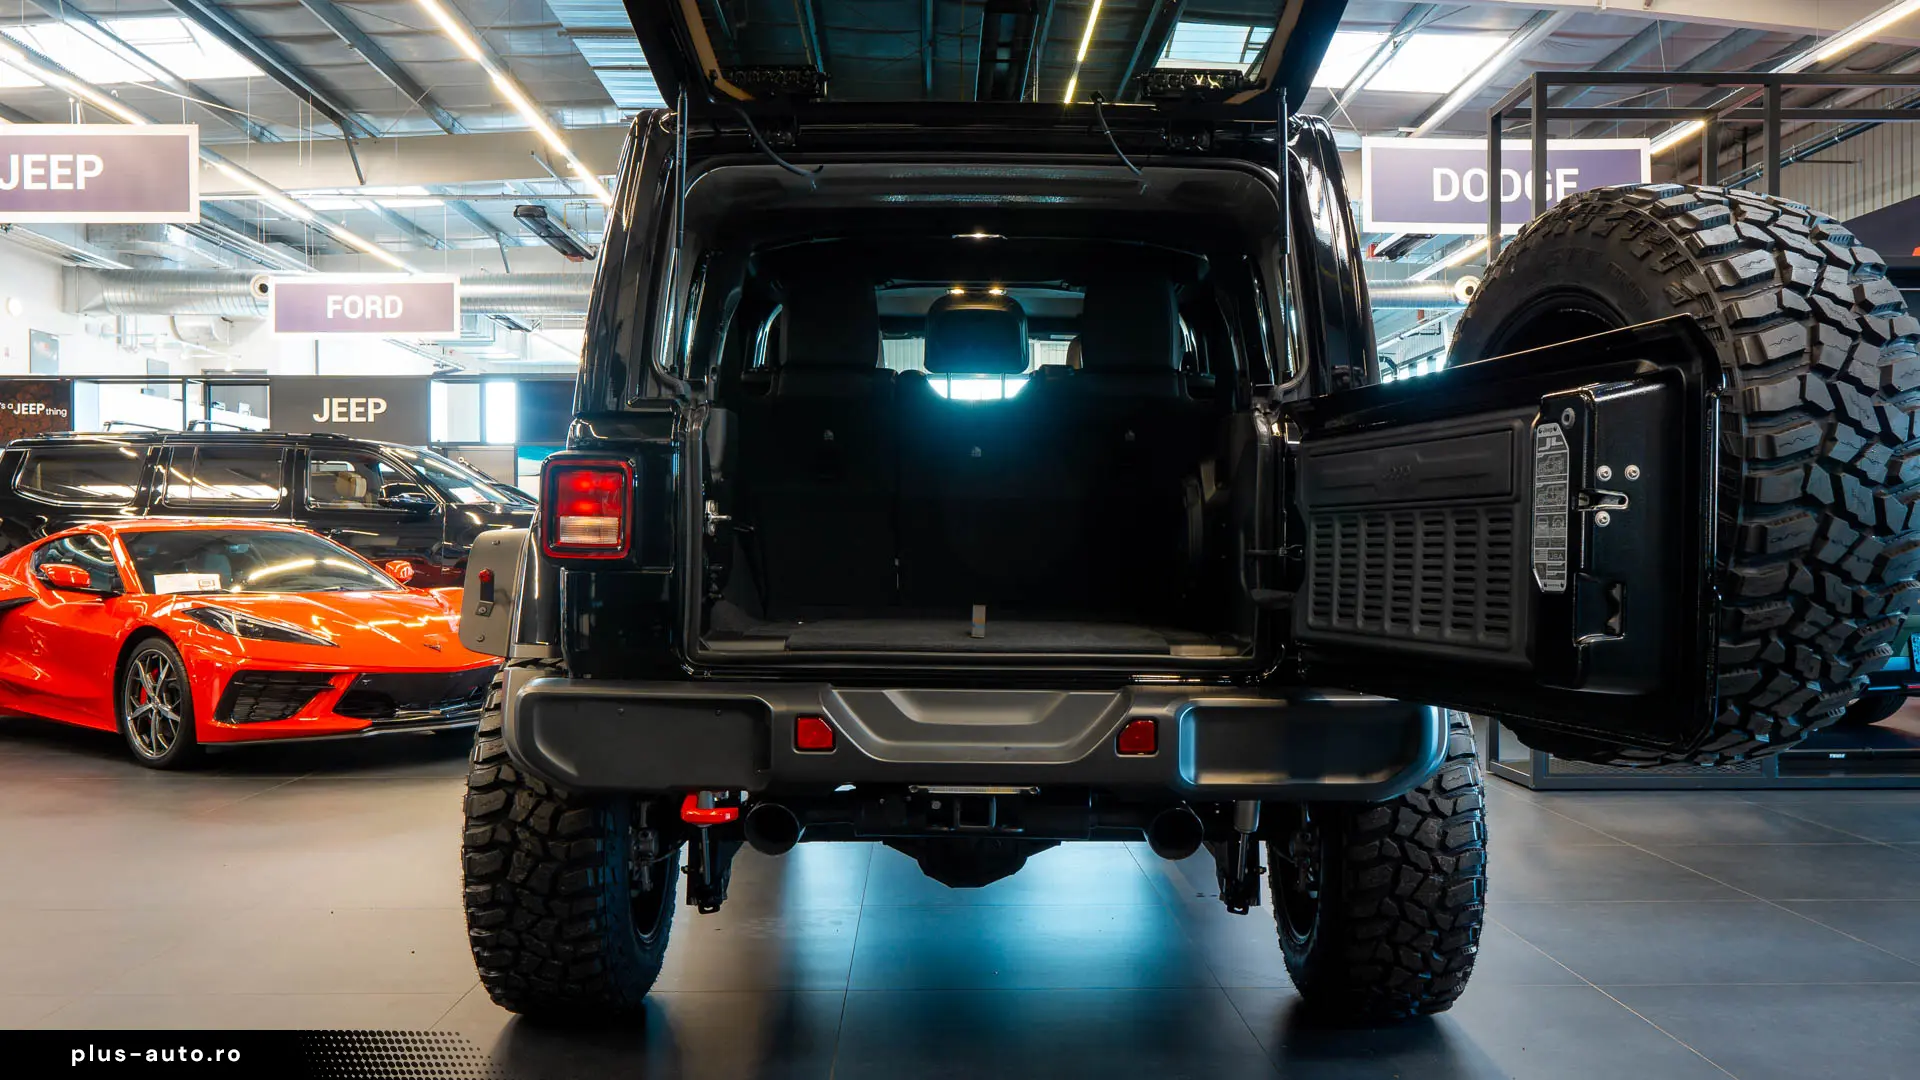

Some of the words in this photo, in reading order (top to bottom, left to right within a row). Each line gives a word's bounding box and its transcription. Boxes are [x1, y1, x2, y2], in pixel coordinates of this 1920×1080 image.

[0, 154, 104, 190] JEEP
[1432, 167, 1579, 202] DODGE
[326, 295, 403, 319] FORD
[13, 403, 45, 415] JEEP
[45, 407, 67, 418] thing
[312, 397, 387, 422] JEEP
[1538, 437, 1563, 451] JL
